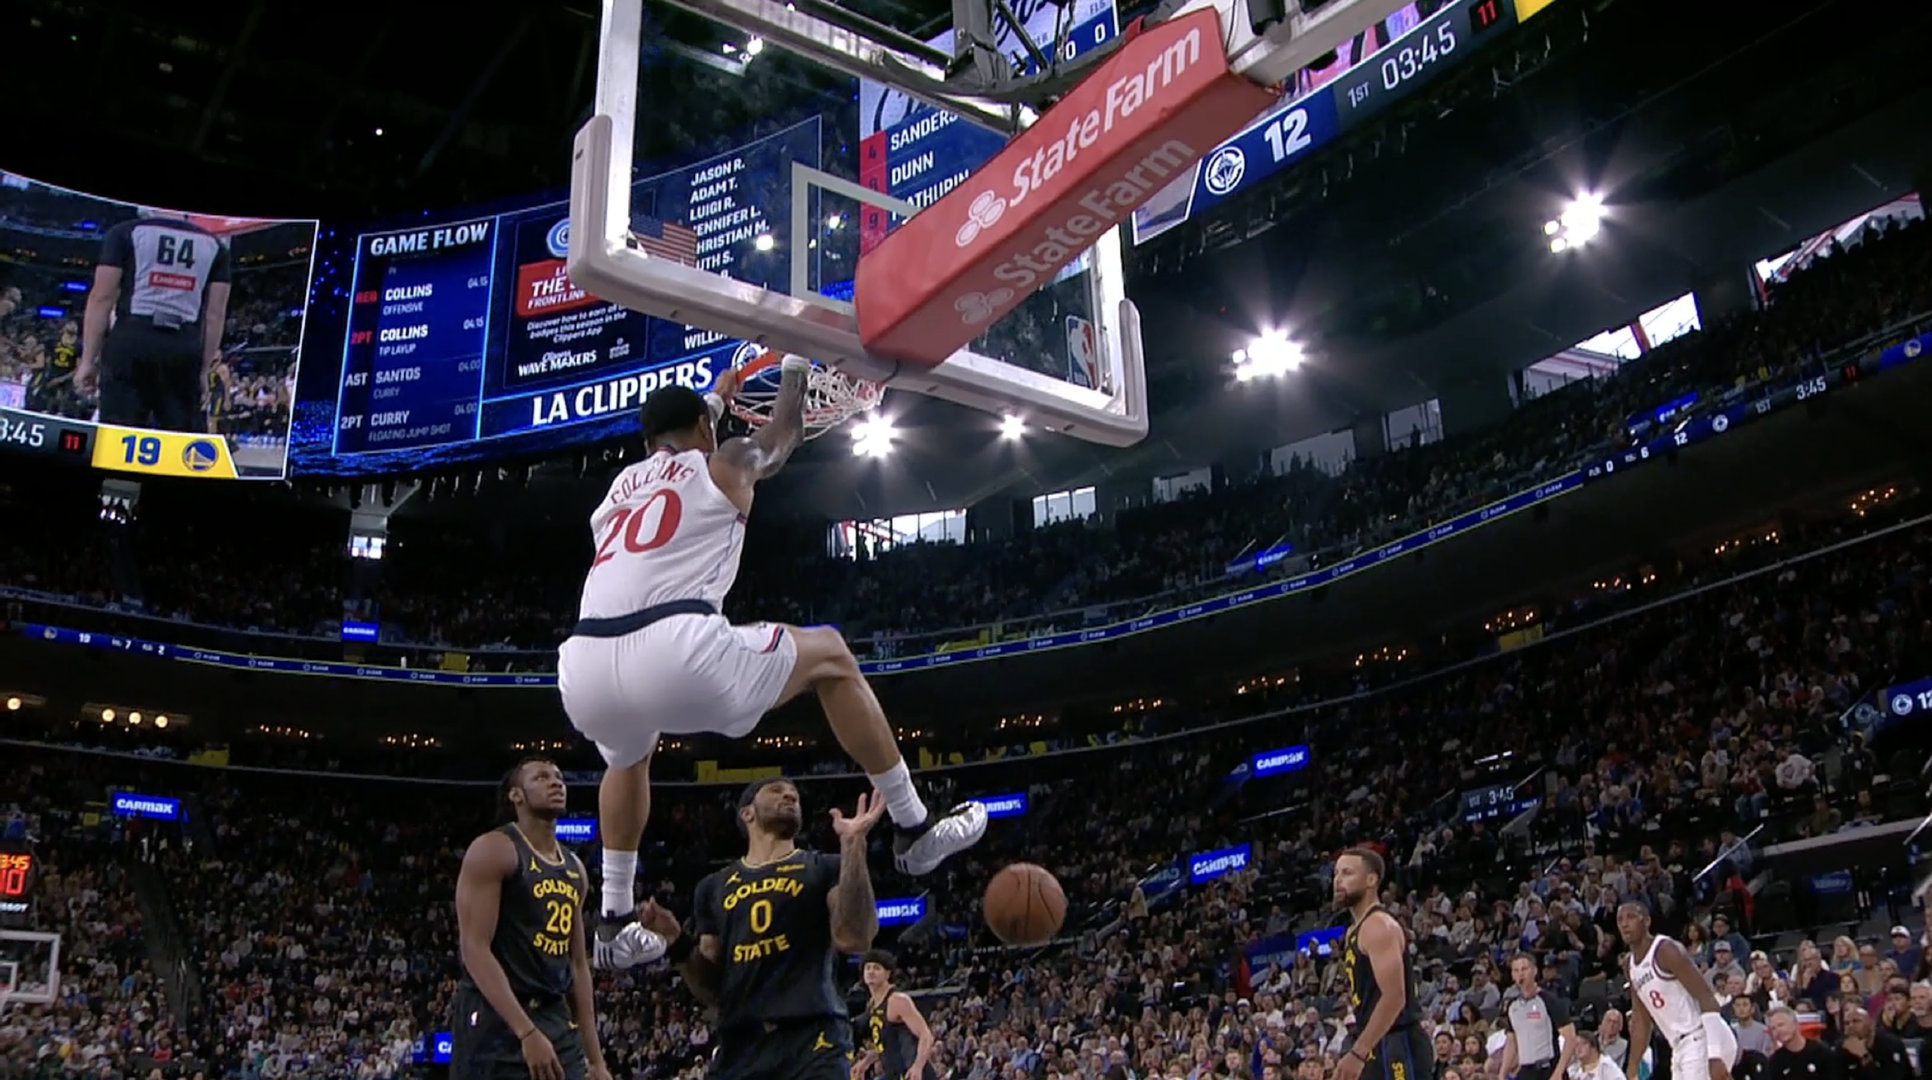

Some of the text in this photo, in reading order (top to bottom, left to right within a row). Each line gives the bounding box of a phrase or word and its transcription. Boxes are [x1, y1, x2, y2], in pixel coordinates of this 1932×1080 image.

[1477, 0, 1497, 27] 11
[1094, 23, 1106, 44] 0
[1347, 20, 1456, 109] 1ST 03:45
[1010, 26, 1200, 208] State Farm
[1264, 107, 1311, 163] 12
[691, 158, 745, 186] JASON R.
[891, 150, 933, 186] DUNN
[690, 177, 738, 204] ADAM T.
[689, 196, 736, 221] LUIGI R.
[693, 205, 761, 237] ENNIFER L.
[993, 138, 1195, 288] State Farm
[371, 222, 489, 256] GAME FLOW
[697, 219, 770, 254] HRISTIAN M.
[157, 235, 195, 269] 64
[696, 250, 734, 270] UTH S.
[385, 283, 433, 301] COLLINS
[532, 276, 567, 297] THE
[383, 301, 424, 316] OFFENSIVE
[351, 330, 372, 345] 2PT
[380, 324, 429, 342] COLLINS
[685, 330, 728, 350] WILLI
[345, 372, 368, 387] AST
[375, 367, 421, 384] SANTOS
[518, 361, 548, 377] WAVE
[550, 349, 597, 371] MAKERS
[532, 357, 713, 426] LA CLIPPERS
[1796, 376, 1827, 400] 3:45
[340, 414, 363, 429] 2PT
[370, 411, 410, 426] CURRY
[64, 434, 80, 450] 11
[122, 435, 161, 466] 19
[1674, 431, 1688, 446] 12
[590, 488, 682, 576] 20
[533, 879, 580, 907] GOLDEN
[723, 877, 804, 910] GOLDEN
[546, 900, 572, 935] 28
[751, 899, 772, 933] 0
[733, 934, 790, 963] STATE
[1649, 990, 1665, 1009] 8
